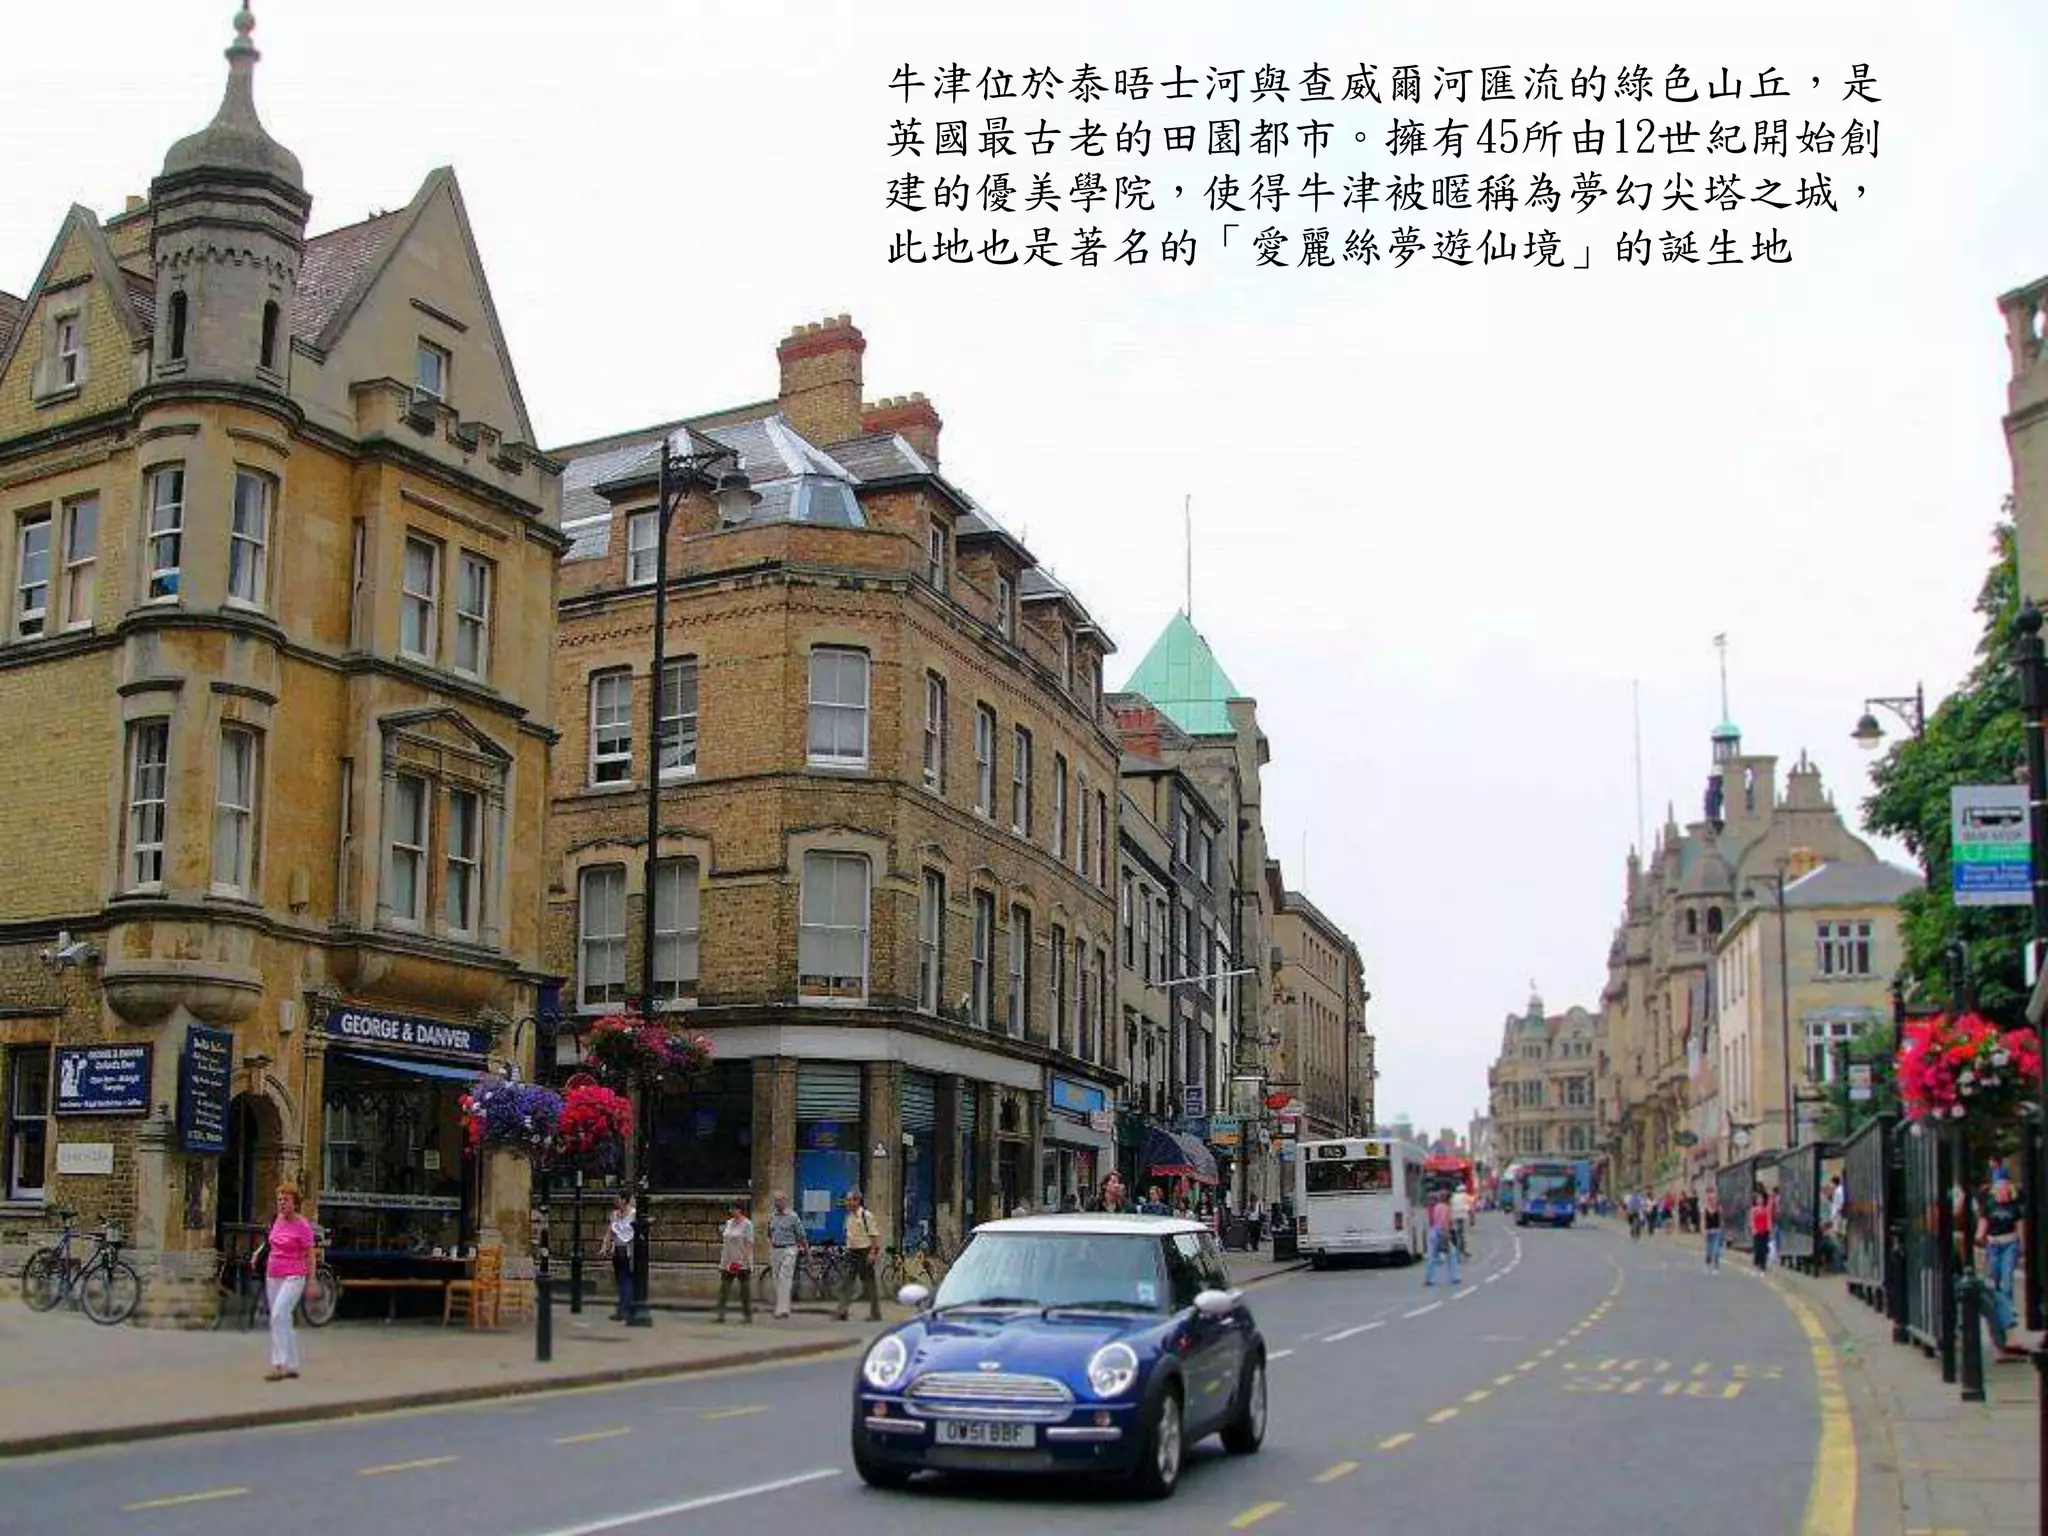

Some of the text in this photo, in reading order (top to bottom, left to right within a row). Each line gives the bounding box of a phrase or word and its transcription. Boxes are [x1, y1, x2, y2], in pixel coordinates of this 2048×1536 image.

[340, 1013, 471, 1049] GEORGE & DANVER
